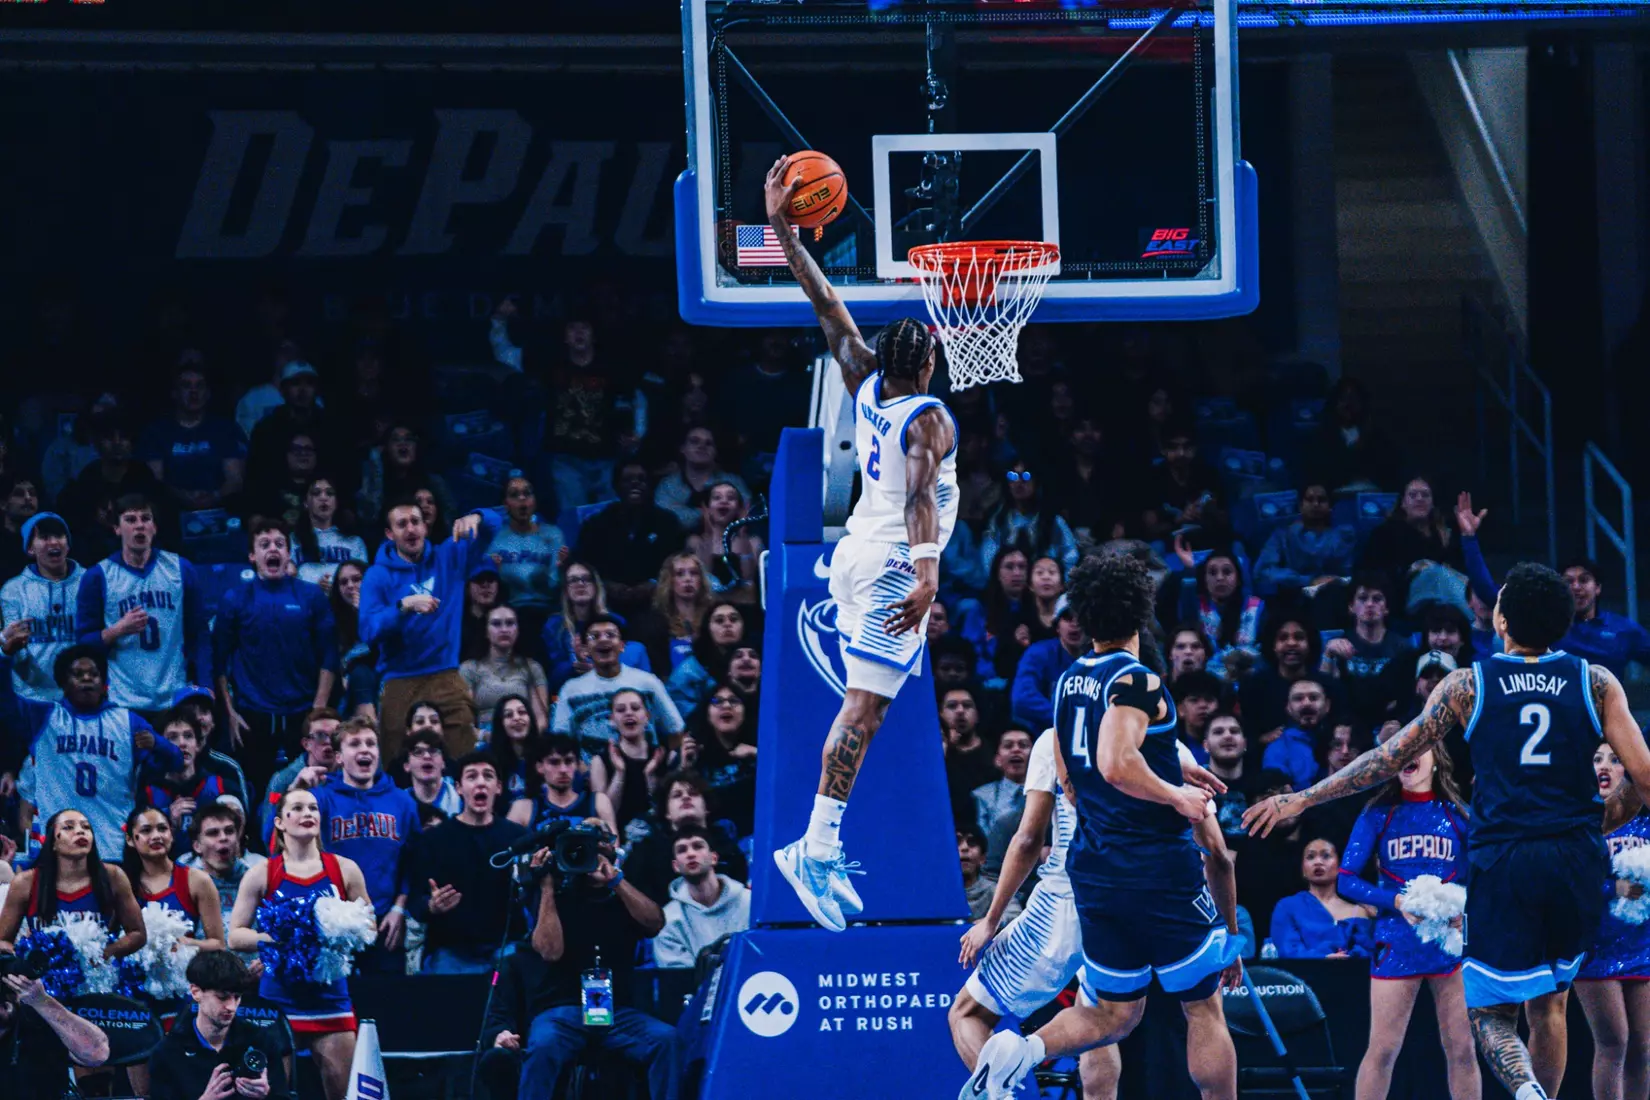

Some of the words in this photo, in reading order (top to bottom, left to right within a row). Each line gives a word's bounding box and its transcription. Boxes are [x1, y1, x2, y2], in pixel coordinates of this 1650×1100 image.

[793, 186, 832, 212] ELITE
[1145, 239, 1200, 252] EAST
[1151, 227, 1192, 241] BIG
[867, 435, 880, 481] 2
[141, 616, 160, 650] 0
[1062, 675, 1102, 702] PERKINS
[1498, 672, 1568, 697] LINDSAY
[1071, 706, 1092, 768] 4
[1519, 702, 1551, 766] 2
[75, 762, 97, 798] 0
[1387, 834, 1457, 862] DEPAUL
[818, 972, 921, 988] MIDWEST
[1222, 984, 1305, 997] PROUCTION
[77, 1007, 150, 1021] COLEMAN
[236, 1005, 279, 1020] EMAN
[818, 993, 953, 1010] ORTHOPAED
[819, 1017, 845, 1032] AT
[856, 1016, 914, 1031] RUSH
